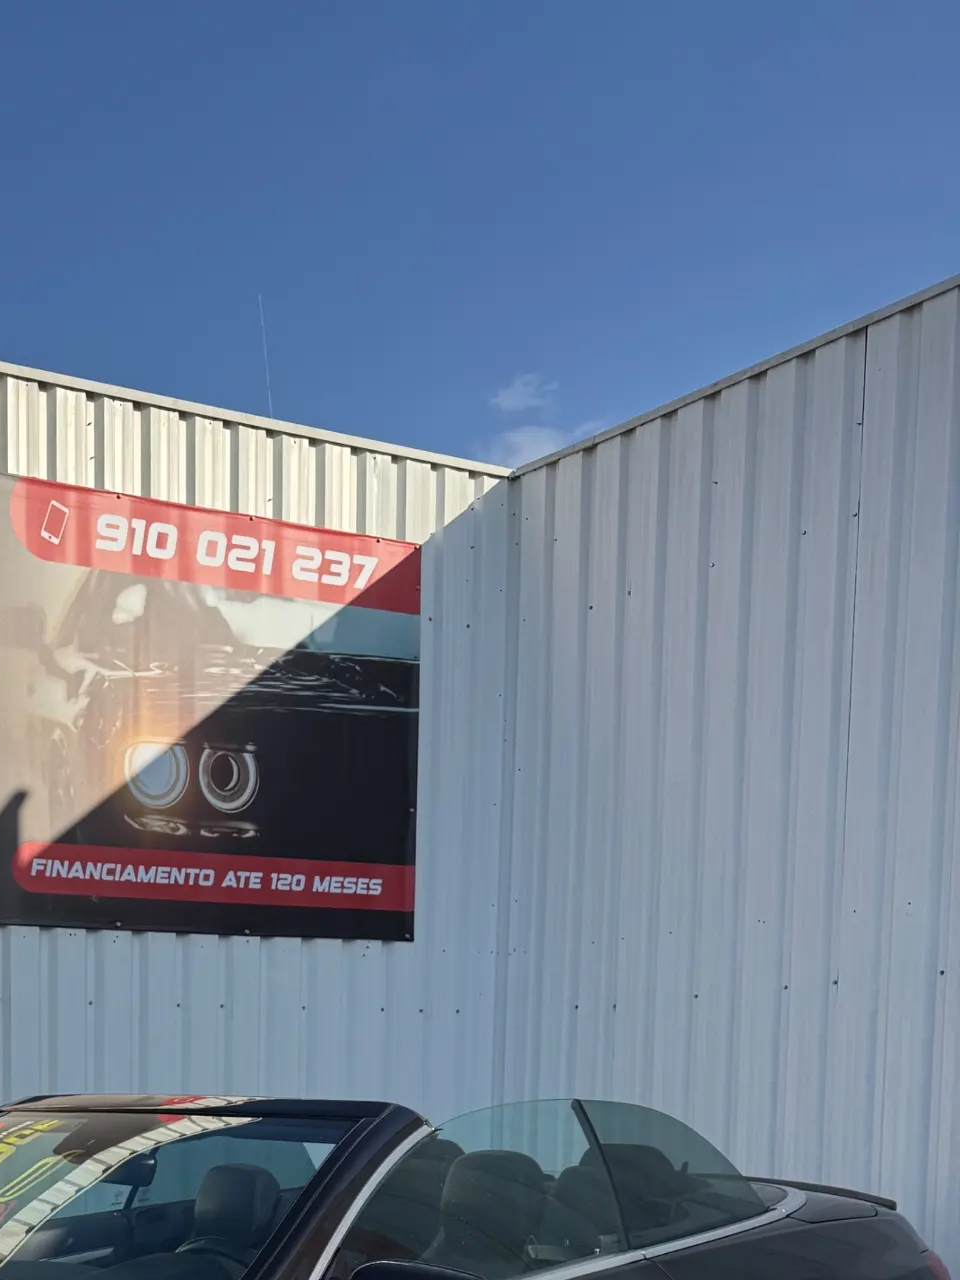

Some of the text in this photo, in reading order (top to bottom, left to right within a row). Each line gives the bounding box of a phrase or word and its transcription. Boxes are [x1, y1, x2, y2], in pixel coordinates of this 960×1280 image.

[95, 513, 379, 589] 910 021 237
[30, 857, 383, 896] FINANCIAMENTO ATE 120 MESES
